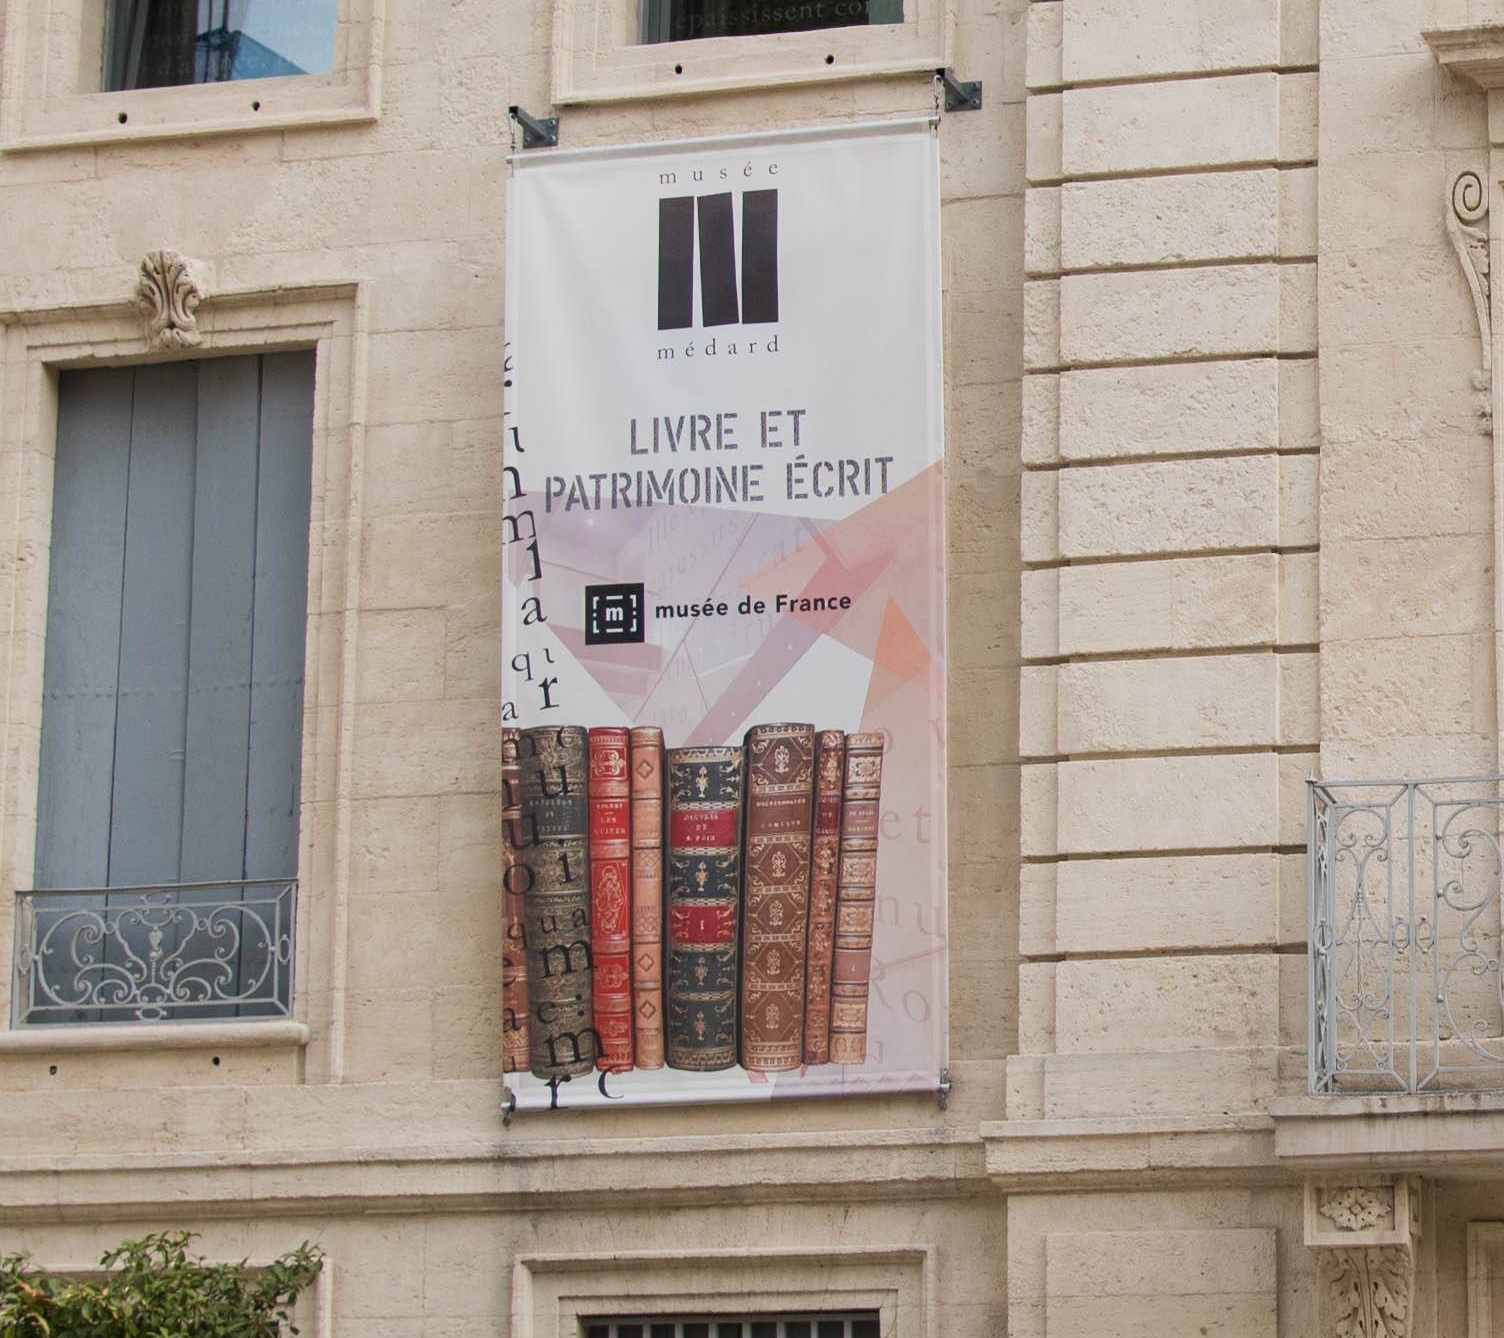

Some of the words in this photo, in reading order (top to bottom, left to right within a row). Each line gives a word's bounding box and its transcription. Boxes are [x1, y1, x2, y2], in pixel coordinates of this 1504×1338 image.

[659, 161, 785, 186] musée
[656, 335, 780, 361] médard
[629, 411, 739, 456] LIVRE
[760, 408, 807, 449] ET
[544, 463, 765, 514] PATRIMOINE
[785, 454, 894, 501] ÉCRIT
[654, 598, 729, 620] musée
[737, 593, 767, 615] de
[775, 592, 853, 614] France
